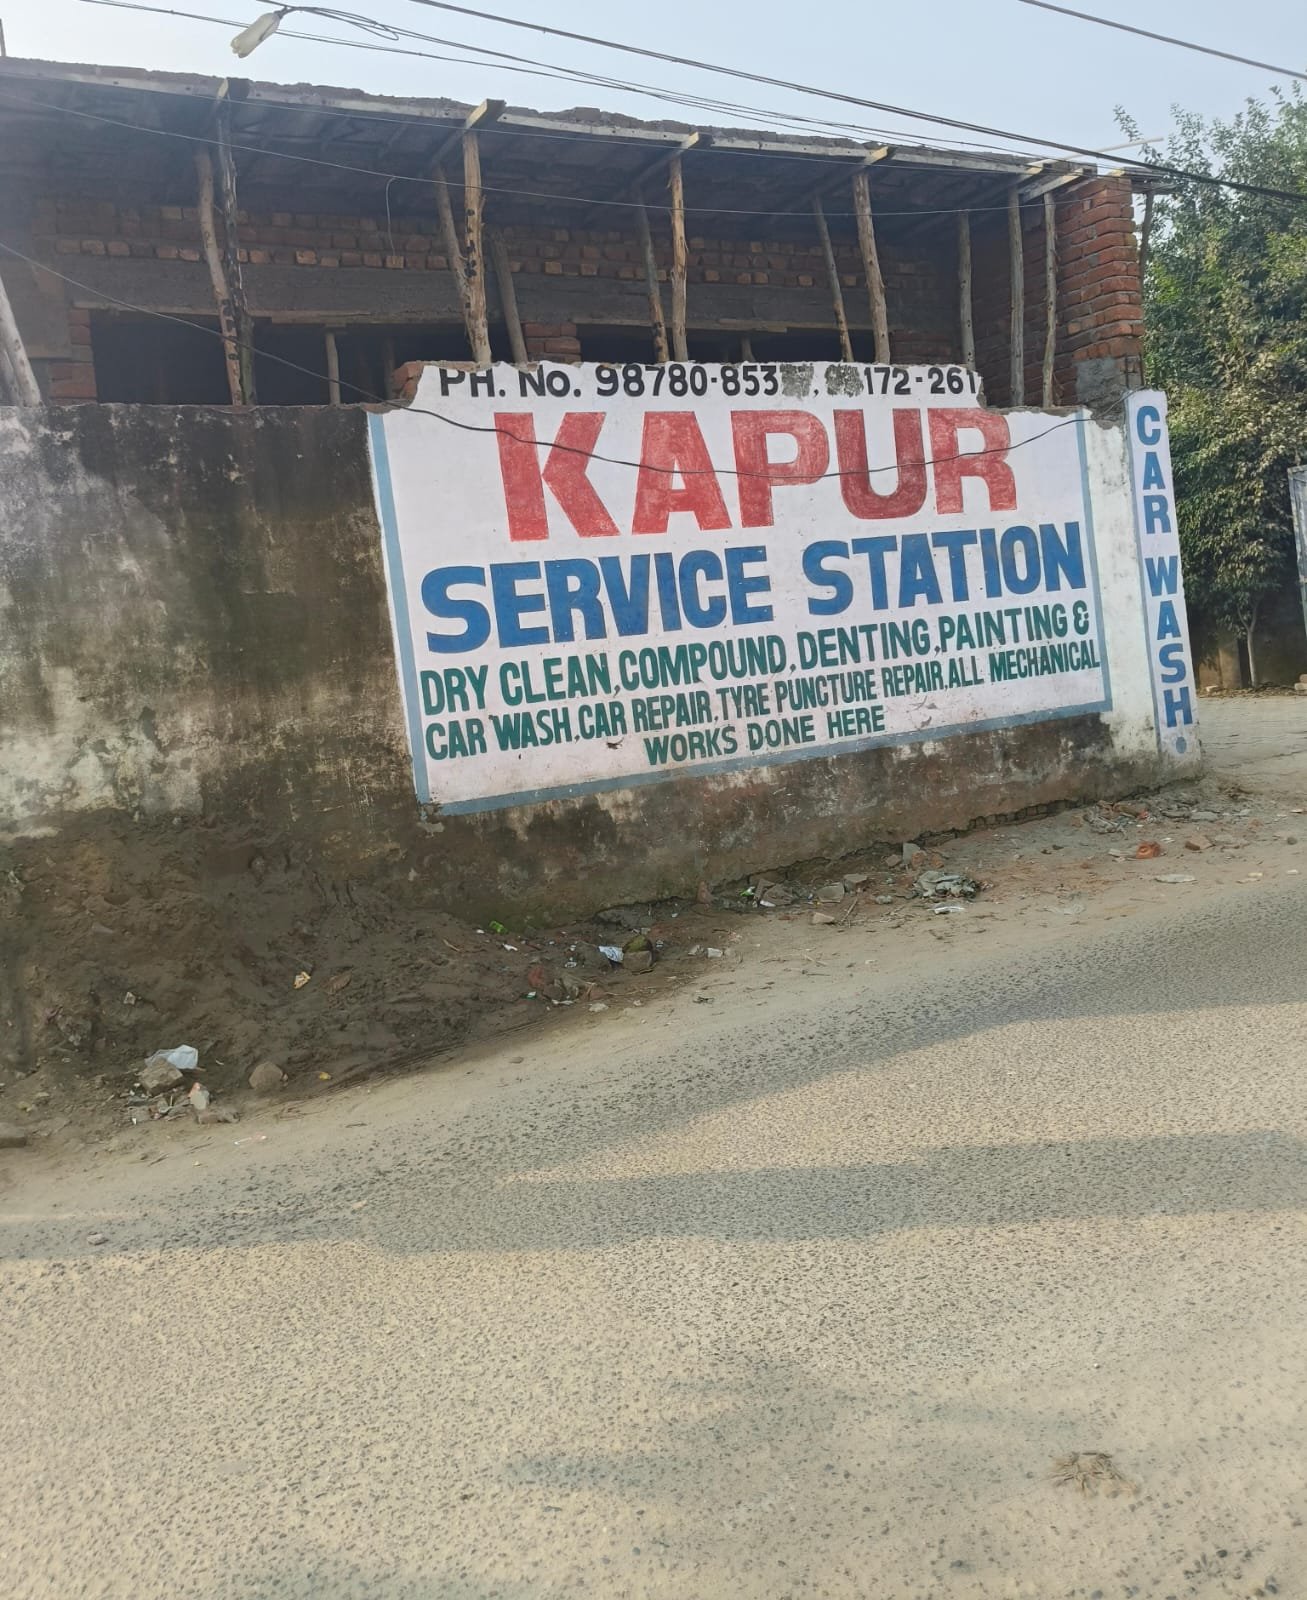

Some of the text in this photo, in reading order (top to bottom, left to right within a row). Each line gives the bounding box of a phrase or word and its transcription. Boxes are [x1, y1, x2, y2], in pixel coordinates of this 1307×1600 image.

[439, 367, 506, 397] PH.
[518, 365, 581, 397] No.
[494, 408, 1017, 542] KAPUR
[1136, 405, 1171, 534] CAR
[421, 521, 1087, 654] SERVICE STATION
[420, 665, 488, 715] DRY
[938, 603, 1067, 652] PAINTING
[1072, 600, 1089, 635] &
[426, 718, 487, 760] CAR
[578, 701, 627, 739] CAR
[716, 680, 770, 720] TYRE
[774, 669, 877, 713] PUNCTURE
[948, 655, 984, 689] ALL
[988, 639, 1100, 682] MECHANICAL
[644, 705, 885, 765] WORKS DONE HERE
